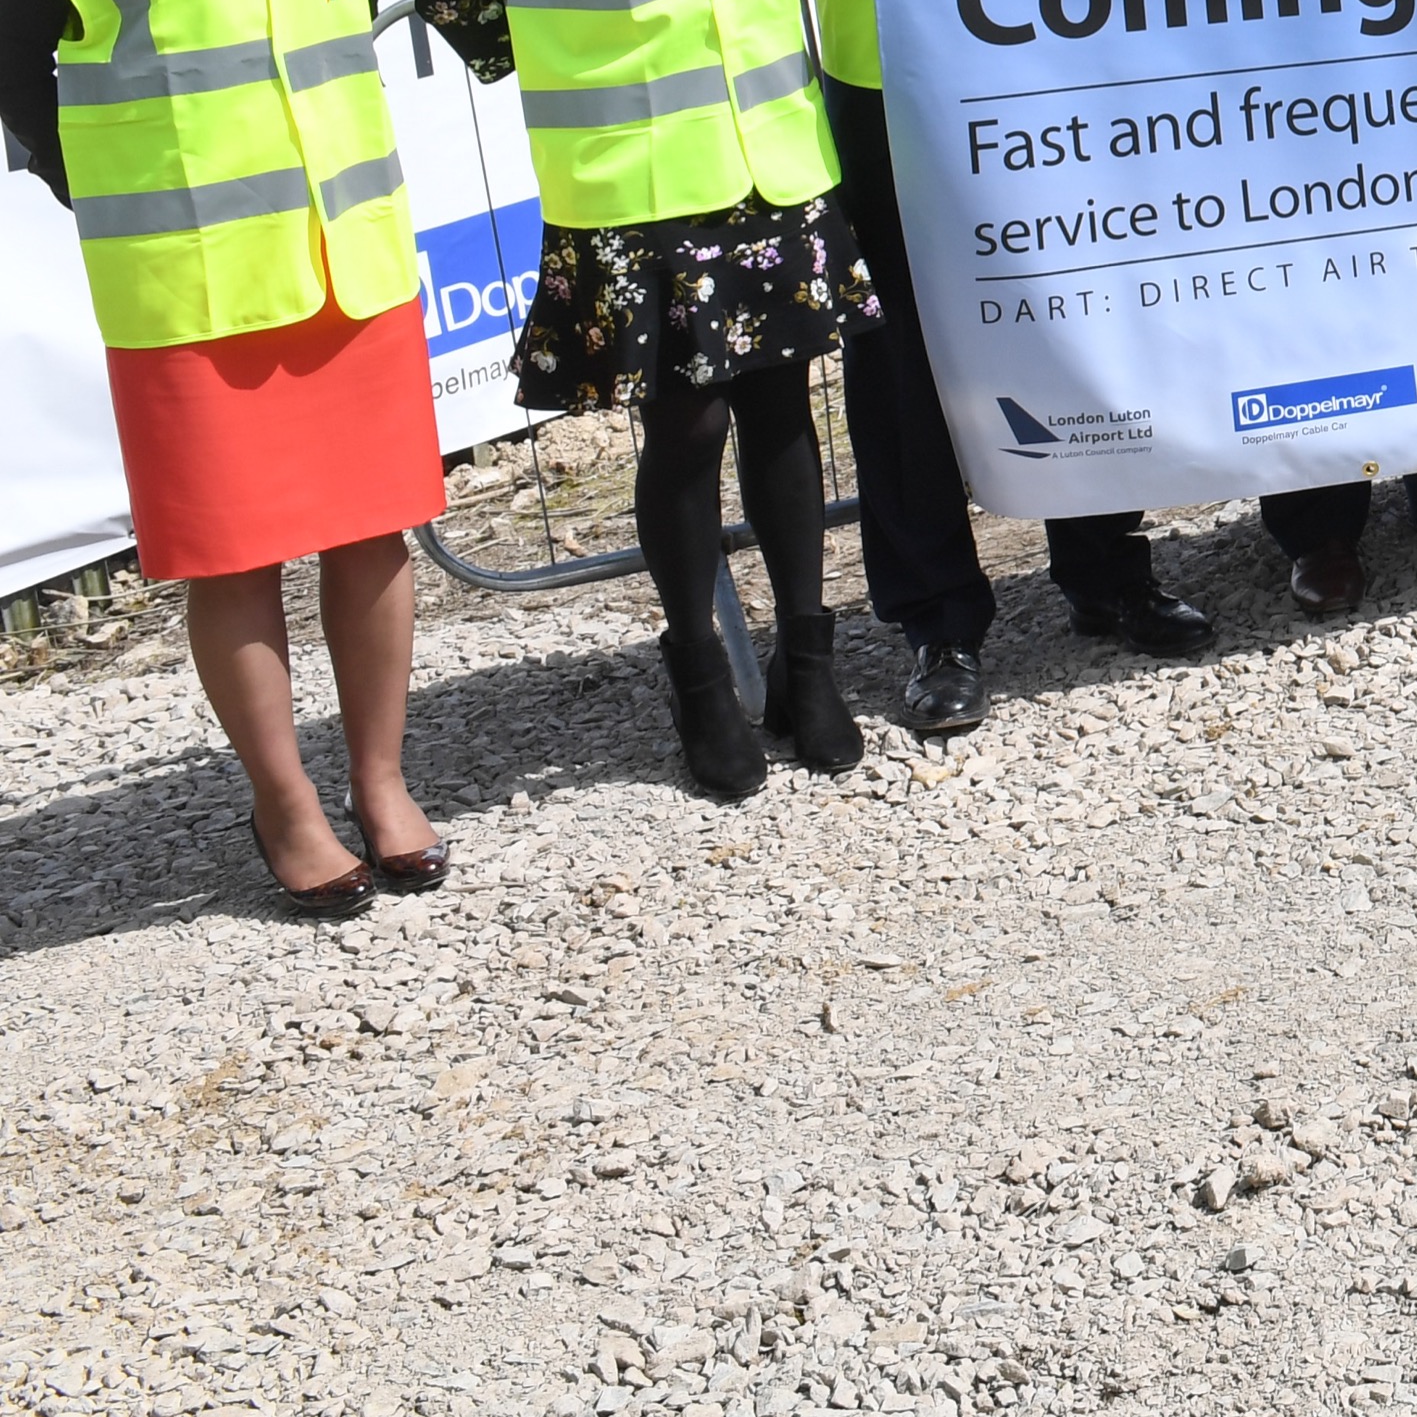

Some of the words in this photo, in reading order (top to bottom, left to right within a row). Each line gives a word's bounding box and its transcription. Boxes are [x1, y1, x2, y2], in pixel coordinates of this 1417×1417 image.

[968, 115, 1091, 174] Fast
[1109, 91, 1223, 158] and
[975, 198, 1158, 256] service
[1172, 192, 1225, 232] to
[980, 290, 1111, 324] DART:
[1140, 263, 1294, 307] DIRECT
[1322, 251, 1387, 282] AIR
[1048, 412, 1104, 427] London
[1109, 409, 1151, 423] Luton
[1268, 390, 1385, 422] Doppelmayr
[1068, 429, 1124, 448] Airport
[1128, 426, 1153, 440] Ltd
[1242, 430, 1299, 445] Doppelmayr
[1302, 423, 1329, 436] Cable
[1331, 422, 1348, 431] Car
[1052, 452, 1058, 460] A
[1059, 450, 1084, 459] Luton
[1085, 447, 1115, 457] Council
[1116, 445, 1153, 457] company
